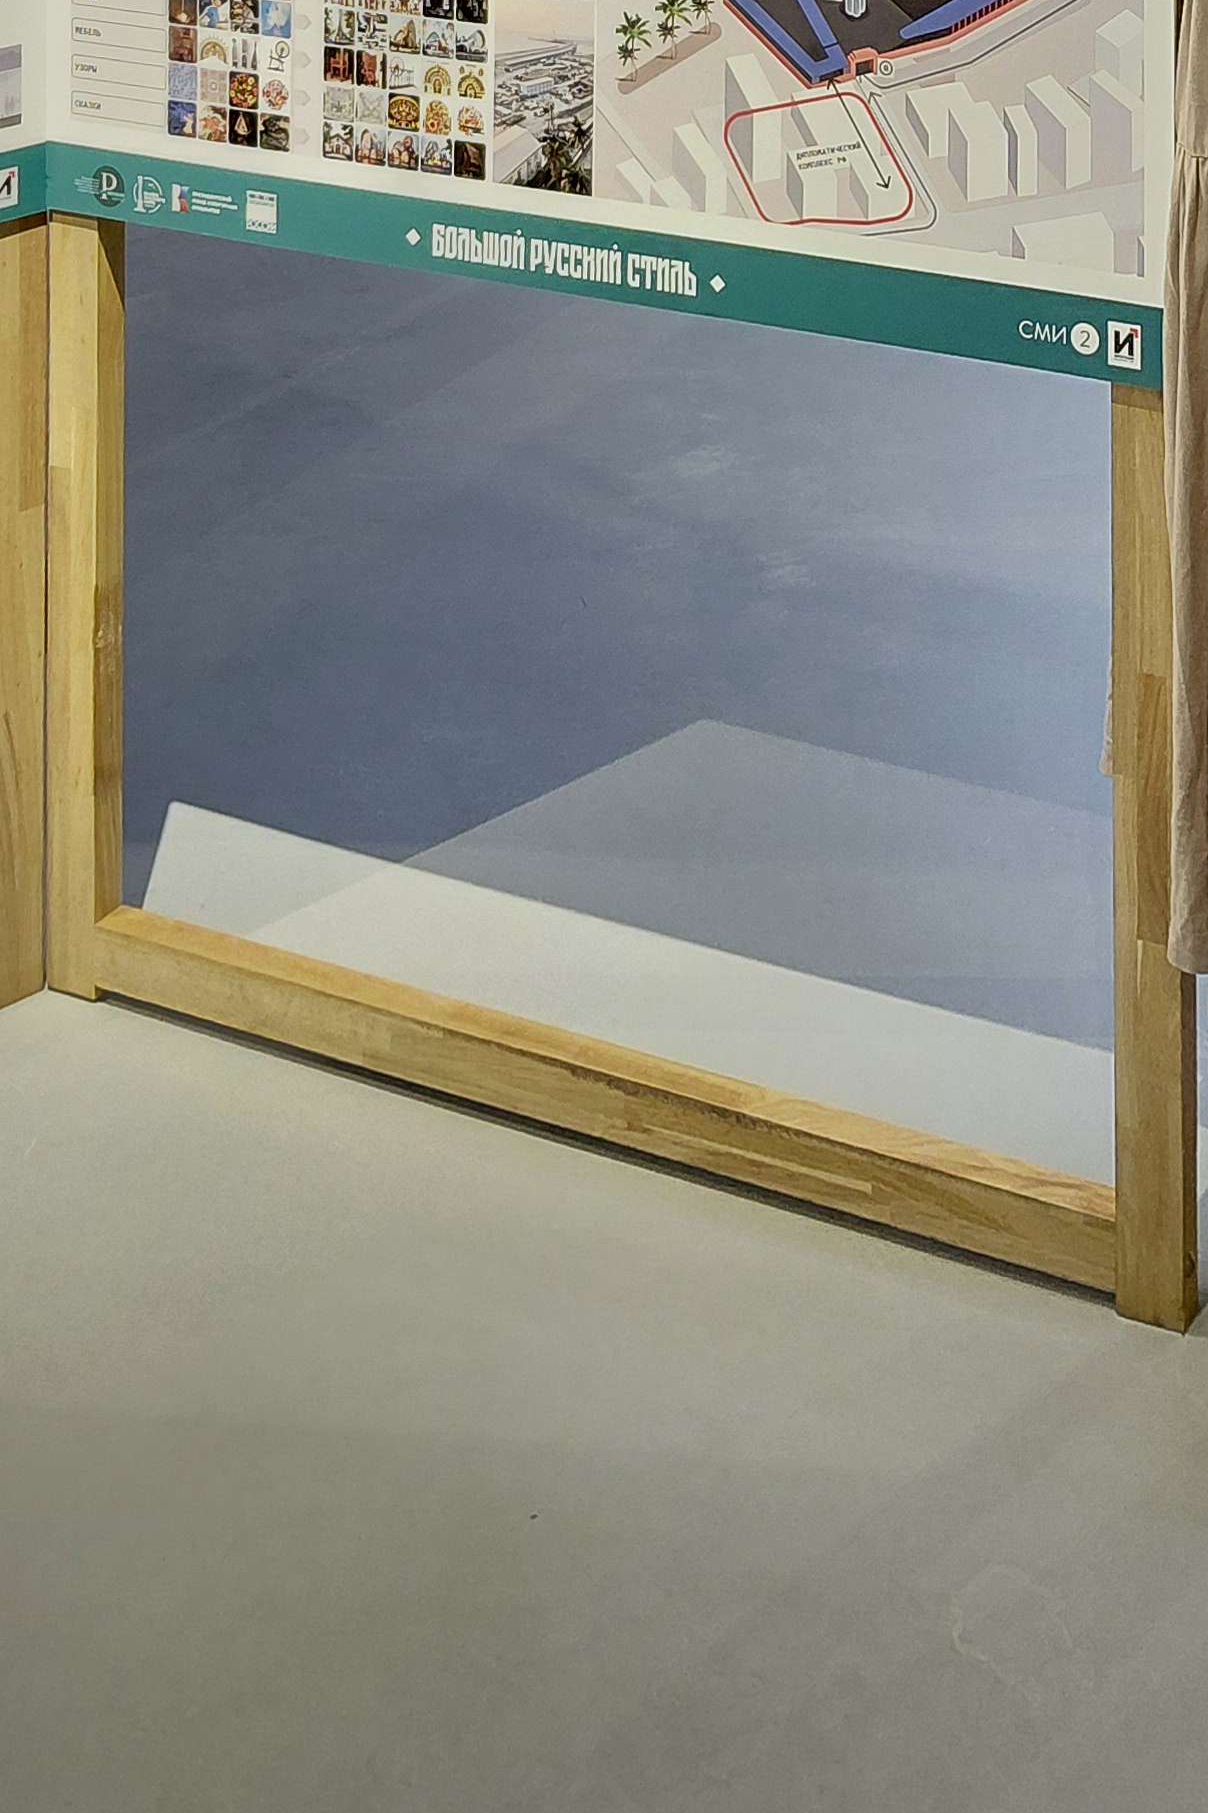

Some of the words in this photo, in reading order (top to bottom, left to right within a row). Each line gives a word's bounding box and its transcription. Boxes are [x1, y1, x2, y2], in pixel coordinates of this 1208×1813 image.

[431, 223, 525, 271] БОЛЬШОЙ
[529, 238, 622, 285] РУССКИЙ
[627, 253, 697, 297] СТИЛЬ
[1018, 320, 1067, 345] СМИ
